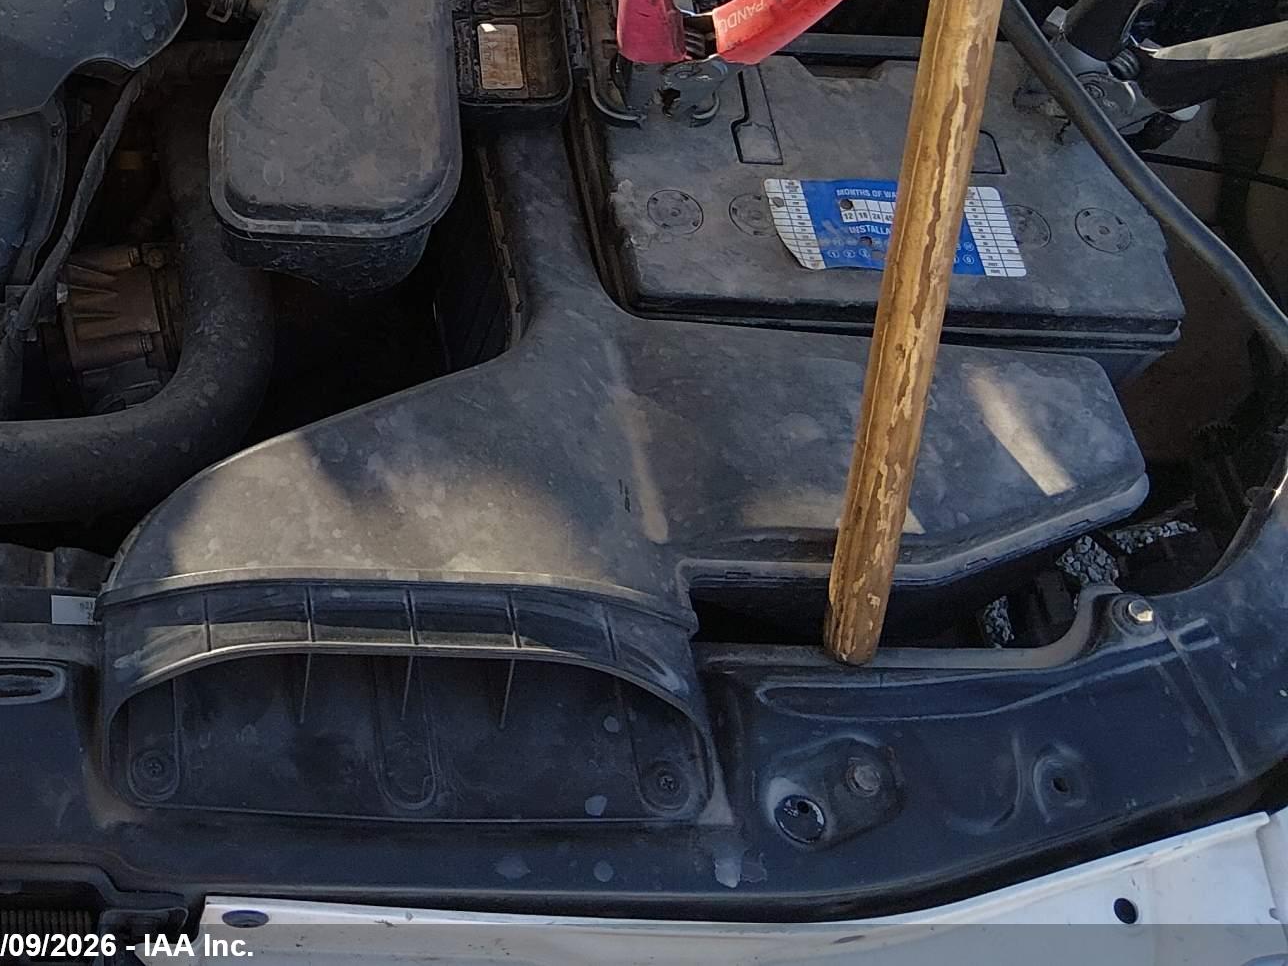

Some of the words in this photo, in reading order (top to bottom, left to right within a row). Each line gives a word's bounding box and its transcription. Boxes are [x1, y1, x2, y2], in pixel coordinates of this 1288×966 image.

[836, 188, 870, 197] MONTHS
[873, 189, 883, 197] OF
[849, 224, 891, 234] INSTALLA
